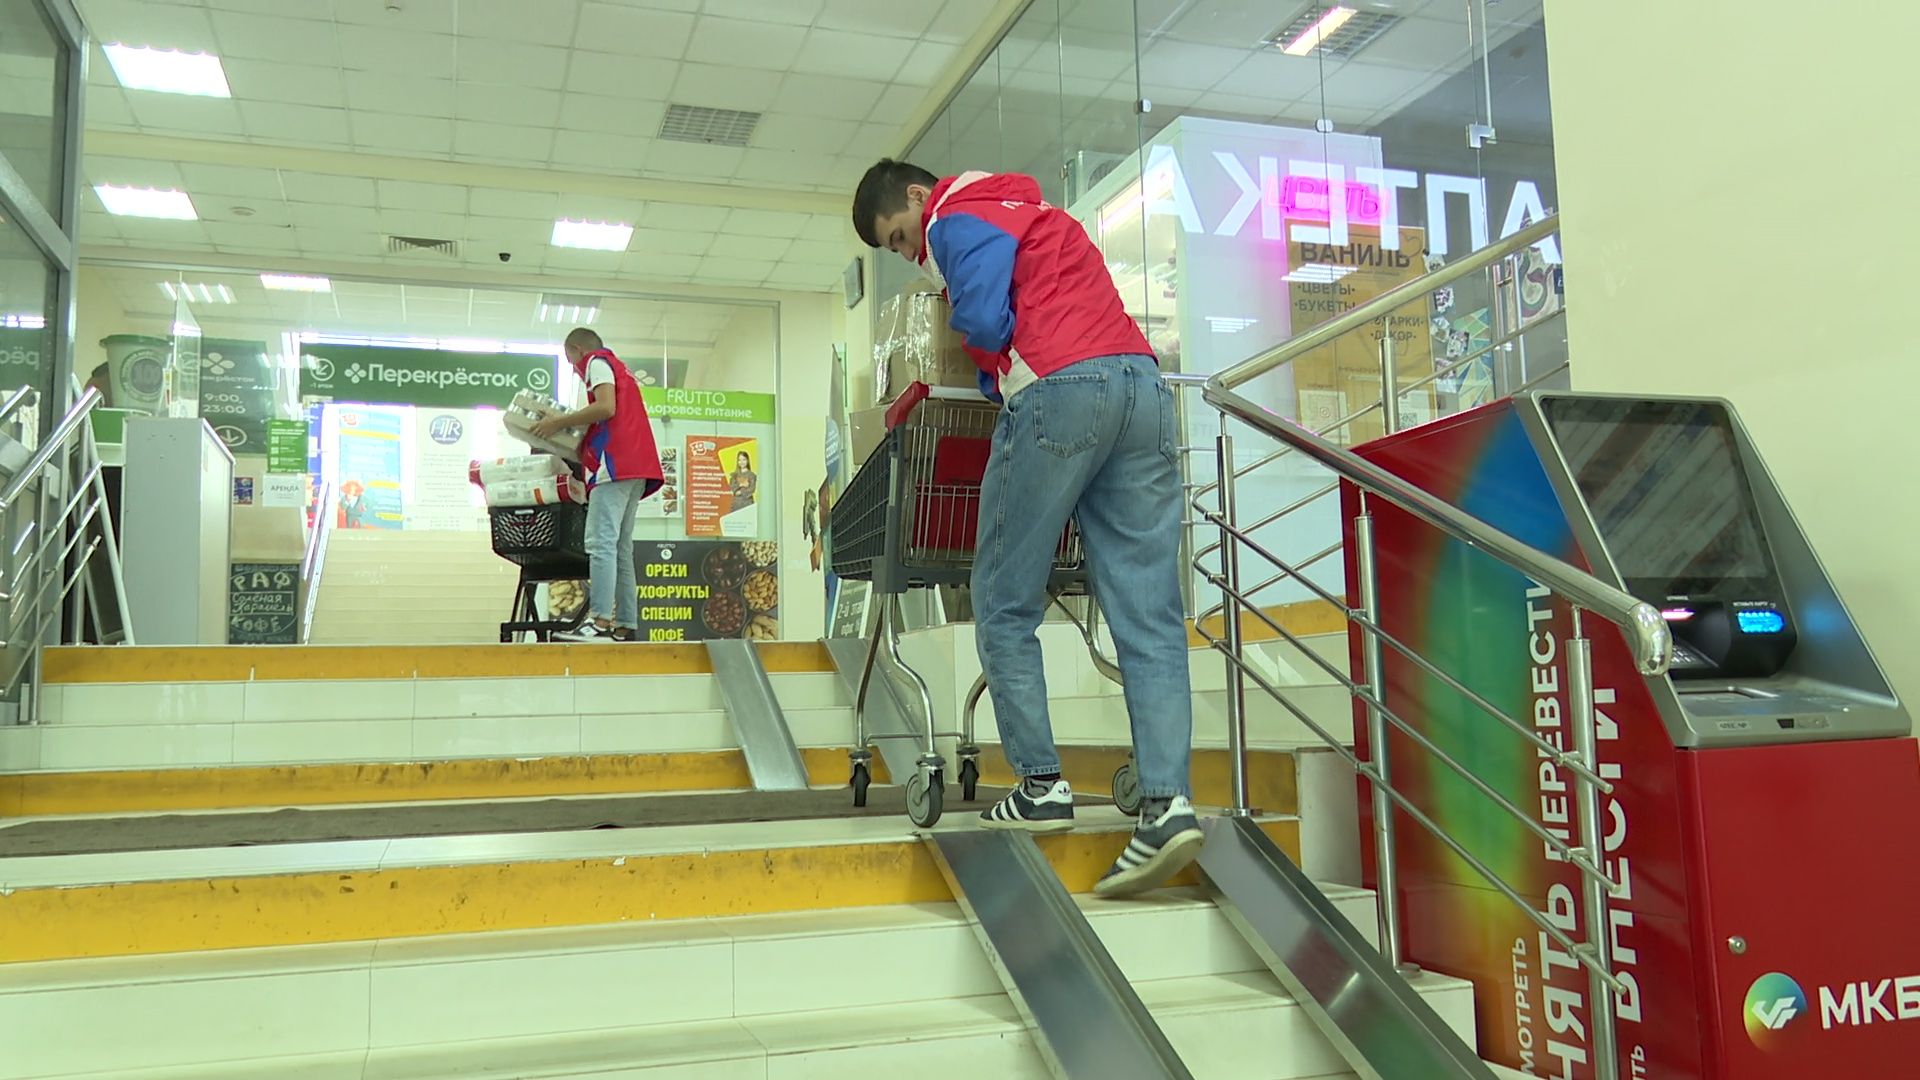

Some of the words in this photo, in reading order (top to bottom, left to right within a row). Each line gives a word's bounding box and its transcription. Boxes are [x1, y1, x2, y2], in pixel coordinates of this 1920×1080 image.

[1301, 242, 1410, 268] ВАНИЛЬ
[1374, 330, 1413, 341] ДКОР
[368, 364, 518, 388] Перекрёсток
[667, 389, 726, 406] FRUTTO
[648, 405, 702, 416] доровое
[705, 407, 753, 418] питание
[645, 563, 688, 577] ОРЕХИ
[636, 585, 710, 599] ХОФРУКТЫ
[641, 606, 693, 621] СПЕЦИИ
[649, 628, 685, 641] КОФЕ
[1538, 883, 1587, 1080] НЯТЬ
[1512, 937, 1535, 1076] МОТРЕТЬ
[1818, 975, 1920, 1030] МКБ
